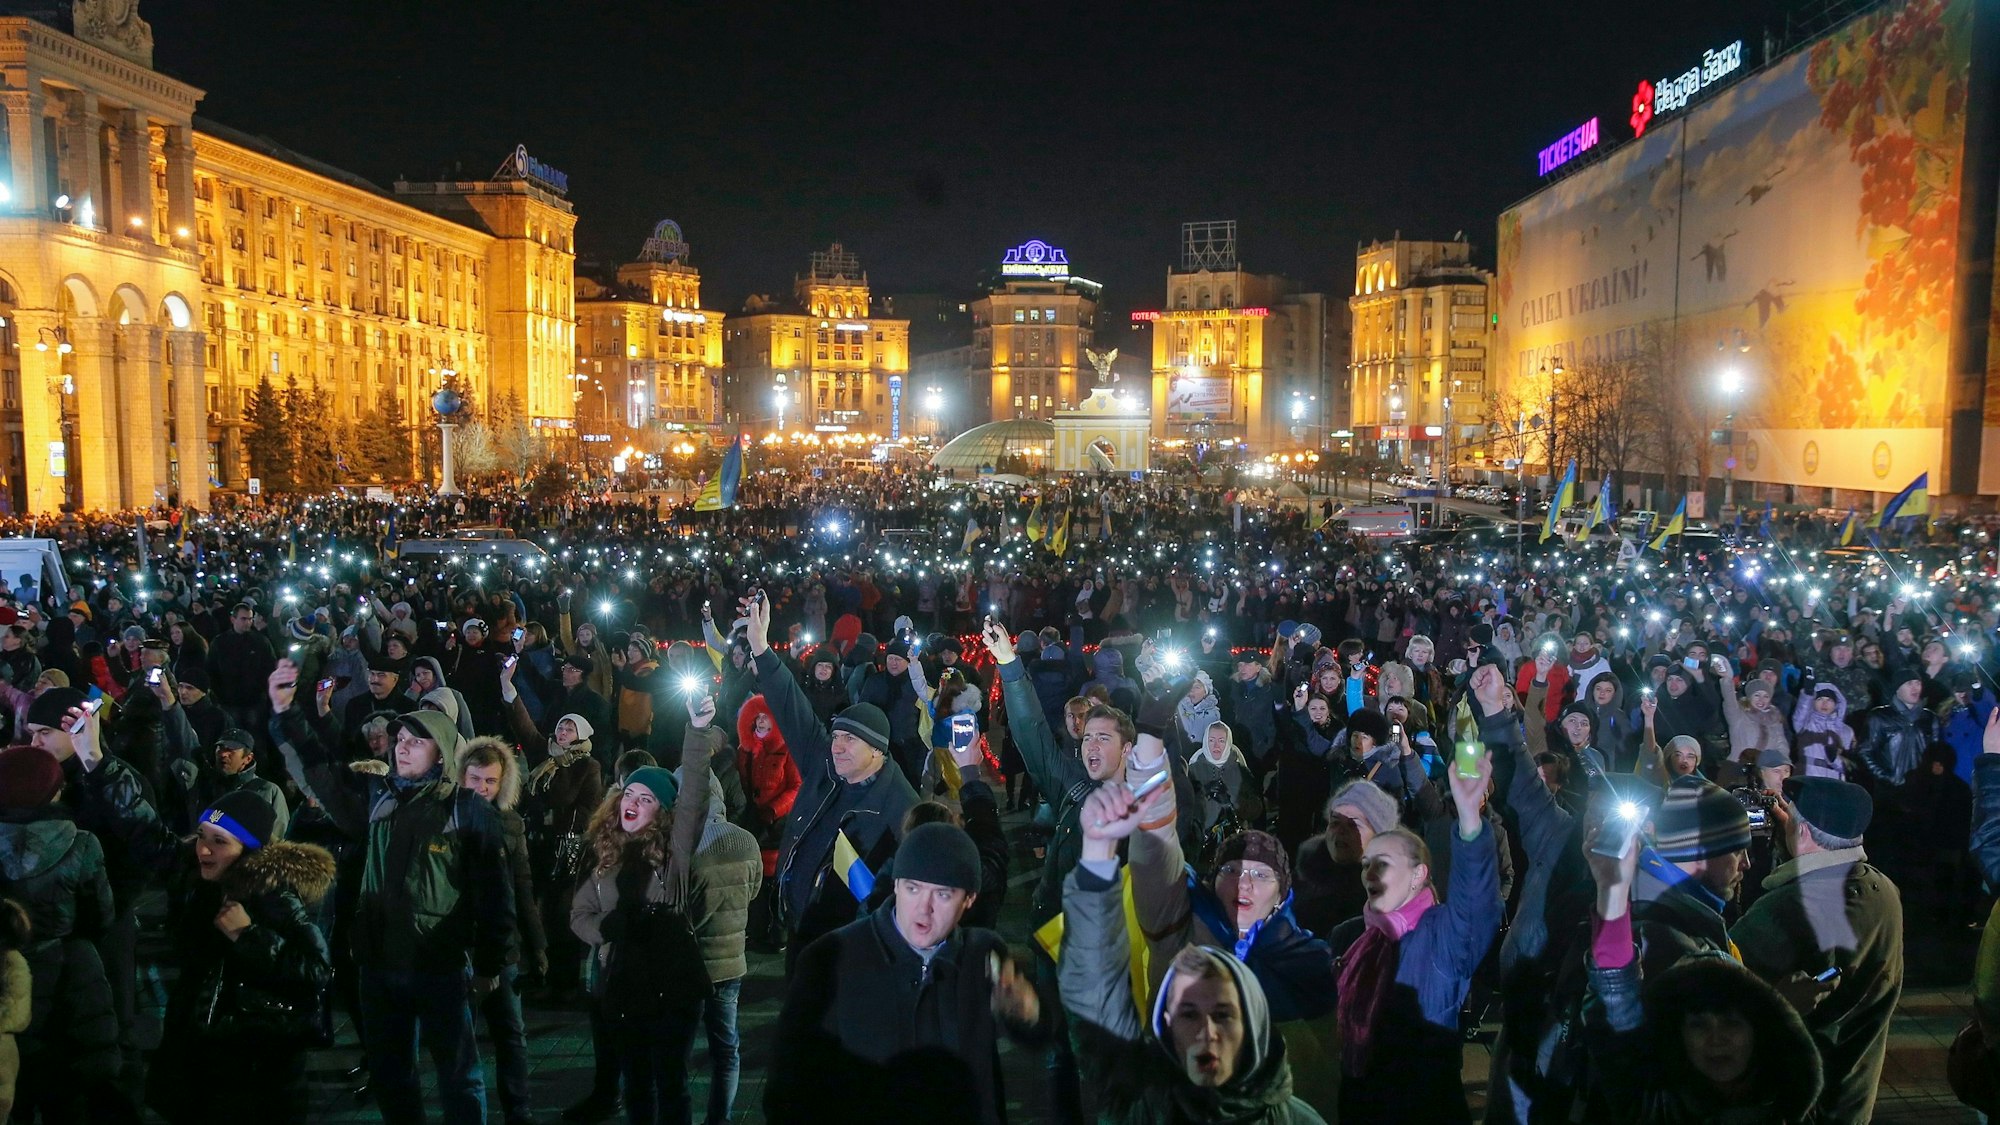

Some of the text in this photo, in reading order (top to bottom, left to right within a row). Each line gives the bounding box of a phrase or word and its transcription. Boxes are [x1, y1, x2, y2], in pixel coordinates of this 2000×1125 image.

[1654, 66, 1700, 115] Надра
[1131, 311, 1160, 321] ГОТЕЛЬ
[1173, 308, 1230, 319] КОЗАЬКИЙ
[1242, 307, 1269, 317] HOTEL
